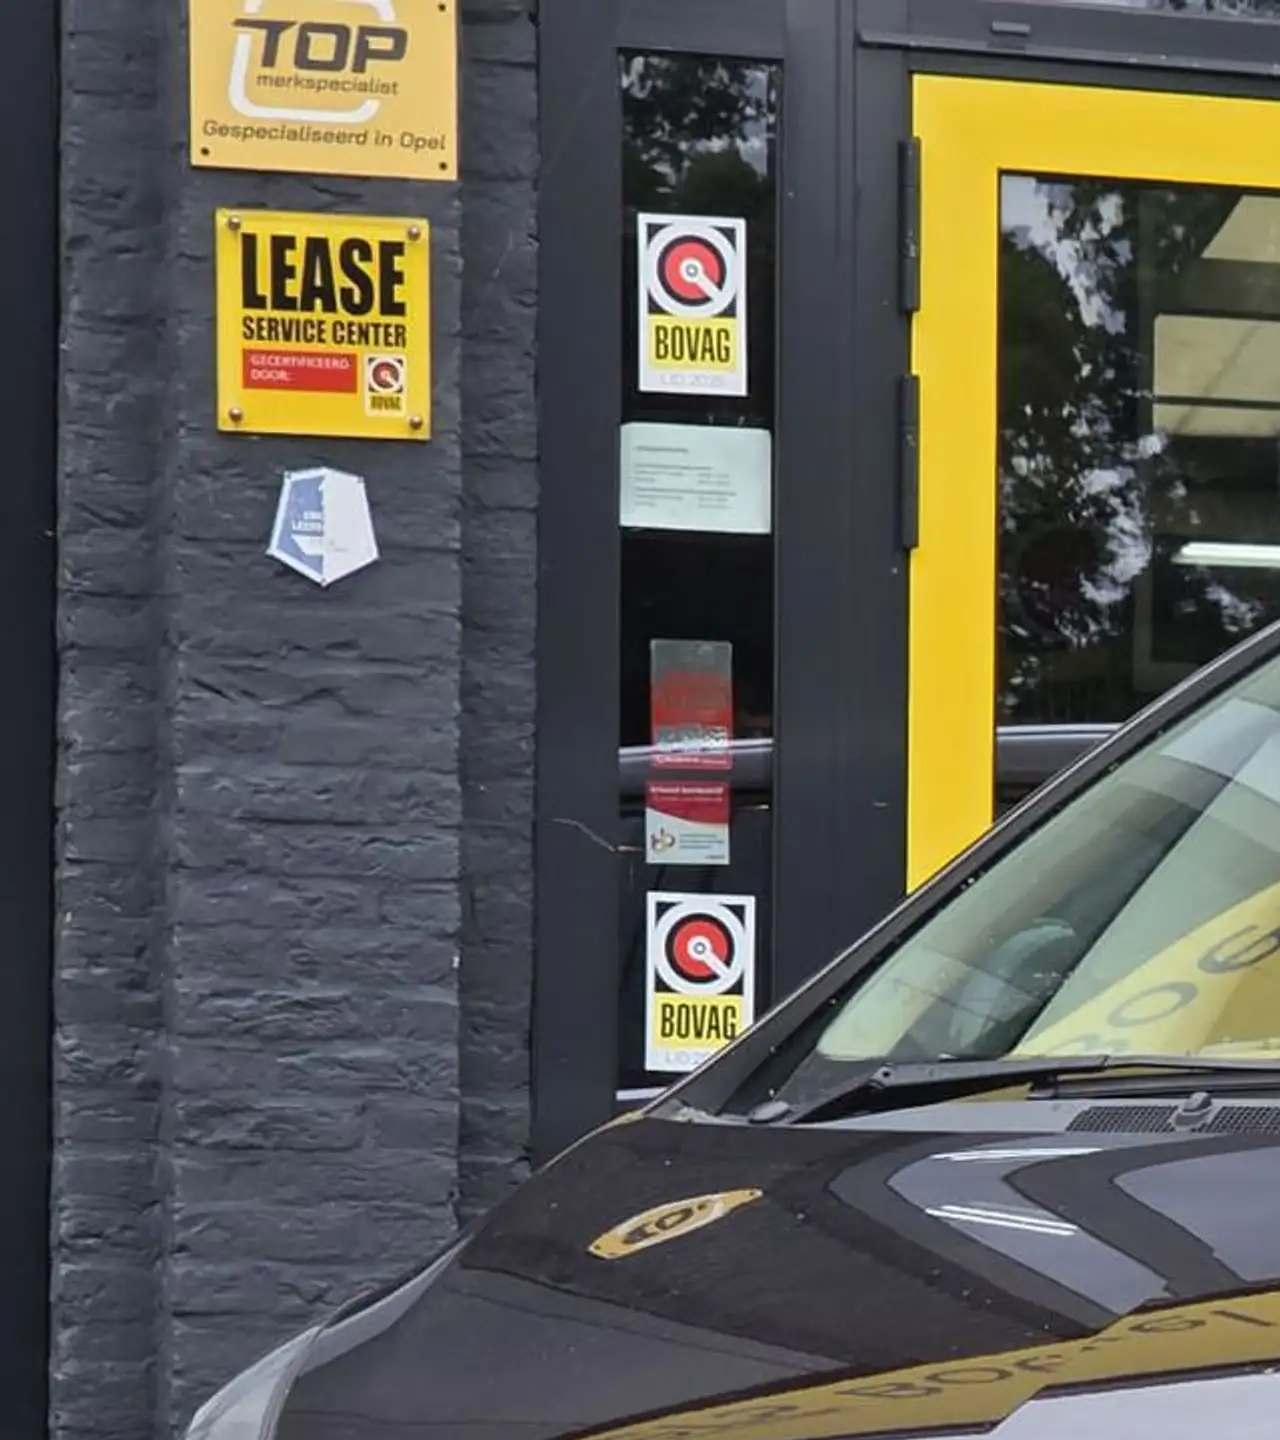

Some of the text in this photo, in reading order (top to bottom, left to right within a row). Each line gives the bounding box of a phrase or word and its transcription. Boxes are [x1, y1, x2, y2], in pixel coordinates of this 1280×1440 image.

[230, 19, 408, 73] TOP
[255, 73, 399, 96] merkspecialist
[202, 119, 446, 152] Gespecialiseerd in Opel
[241, 233, 407, 317] LEASE
[242, 316, 407, 348] SERVICE CENTER
[654, 324, 731, 363] BOVAG
[661, 1003, 736, 1040] BOVAG
